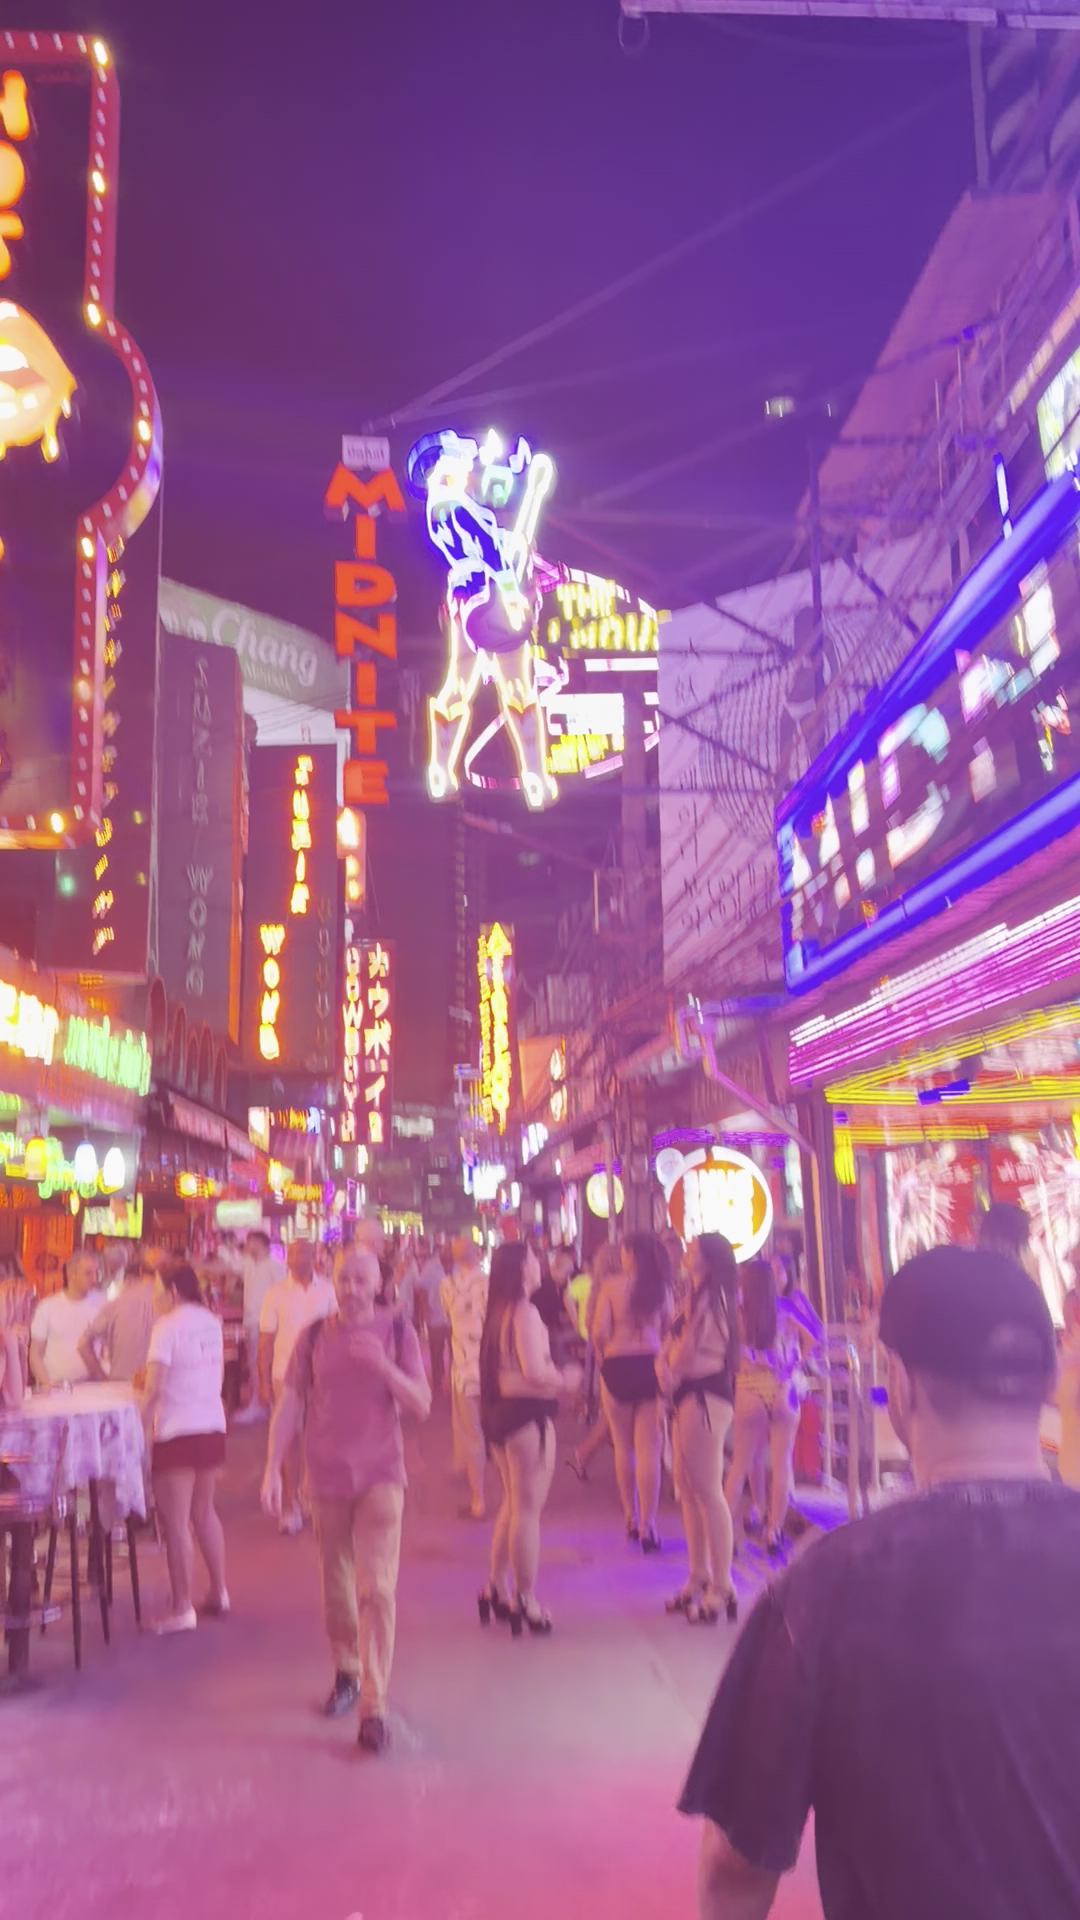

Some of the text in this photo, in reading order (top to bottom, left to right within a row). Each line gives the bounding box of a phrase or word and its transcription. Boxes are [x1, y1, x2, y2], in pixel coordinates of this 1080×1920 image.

[212, 608, 319, 687] Chang
[326, 462, 407, 804] MIDNITE
[342, 947, 364, 1110] COWBOY
